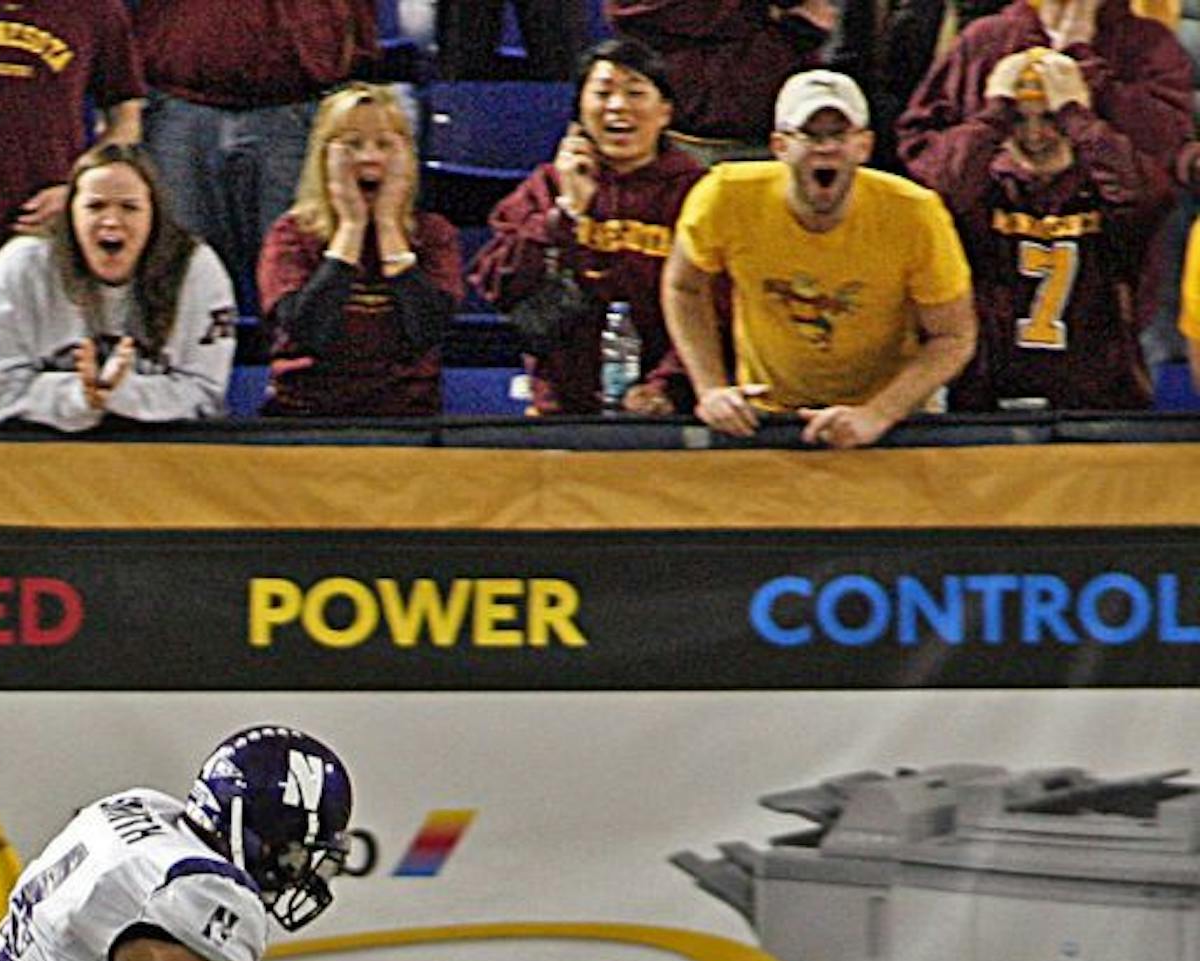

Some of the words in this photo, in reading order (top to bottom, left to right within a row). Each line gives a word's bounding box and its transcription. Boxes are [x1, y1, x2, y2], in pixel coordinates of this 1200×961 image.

[1015, 240, 1079, 349] 7
[248, 578, 588, 647] POWER
[749, 573, 1200, 647] CONTROL
